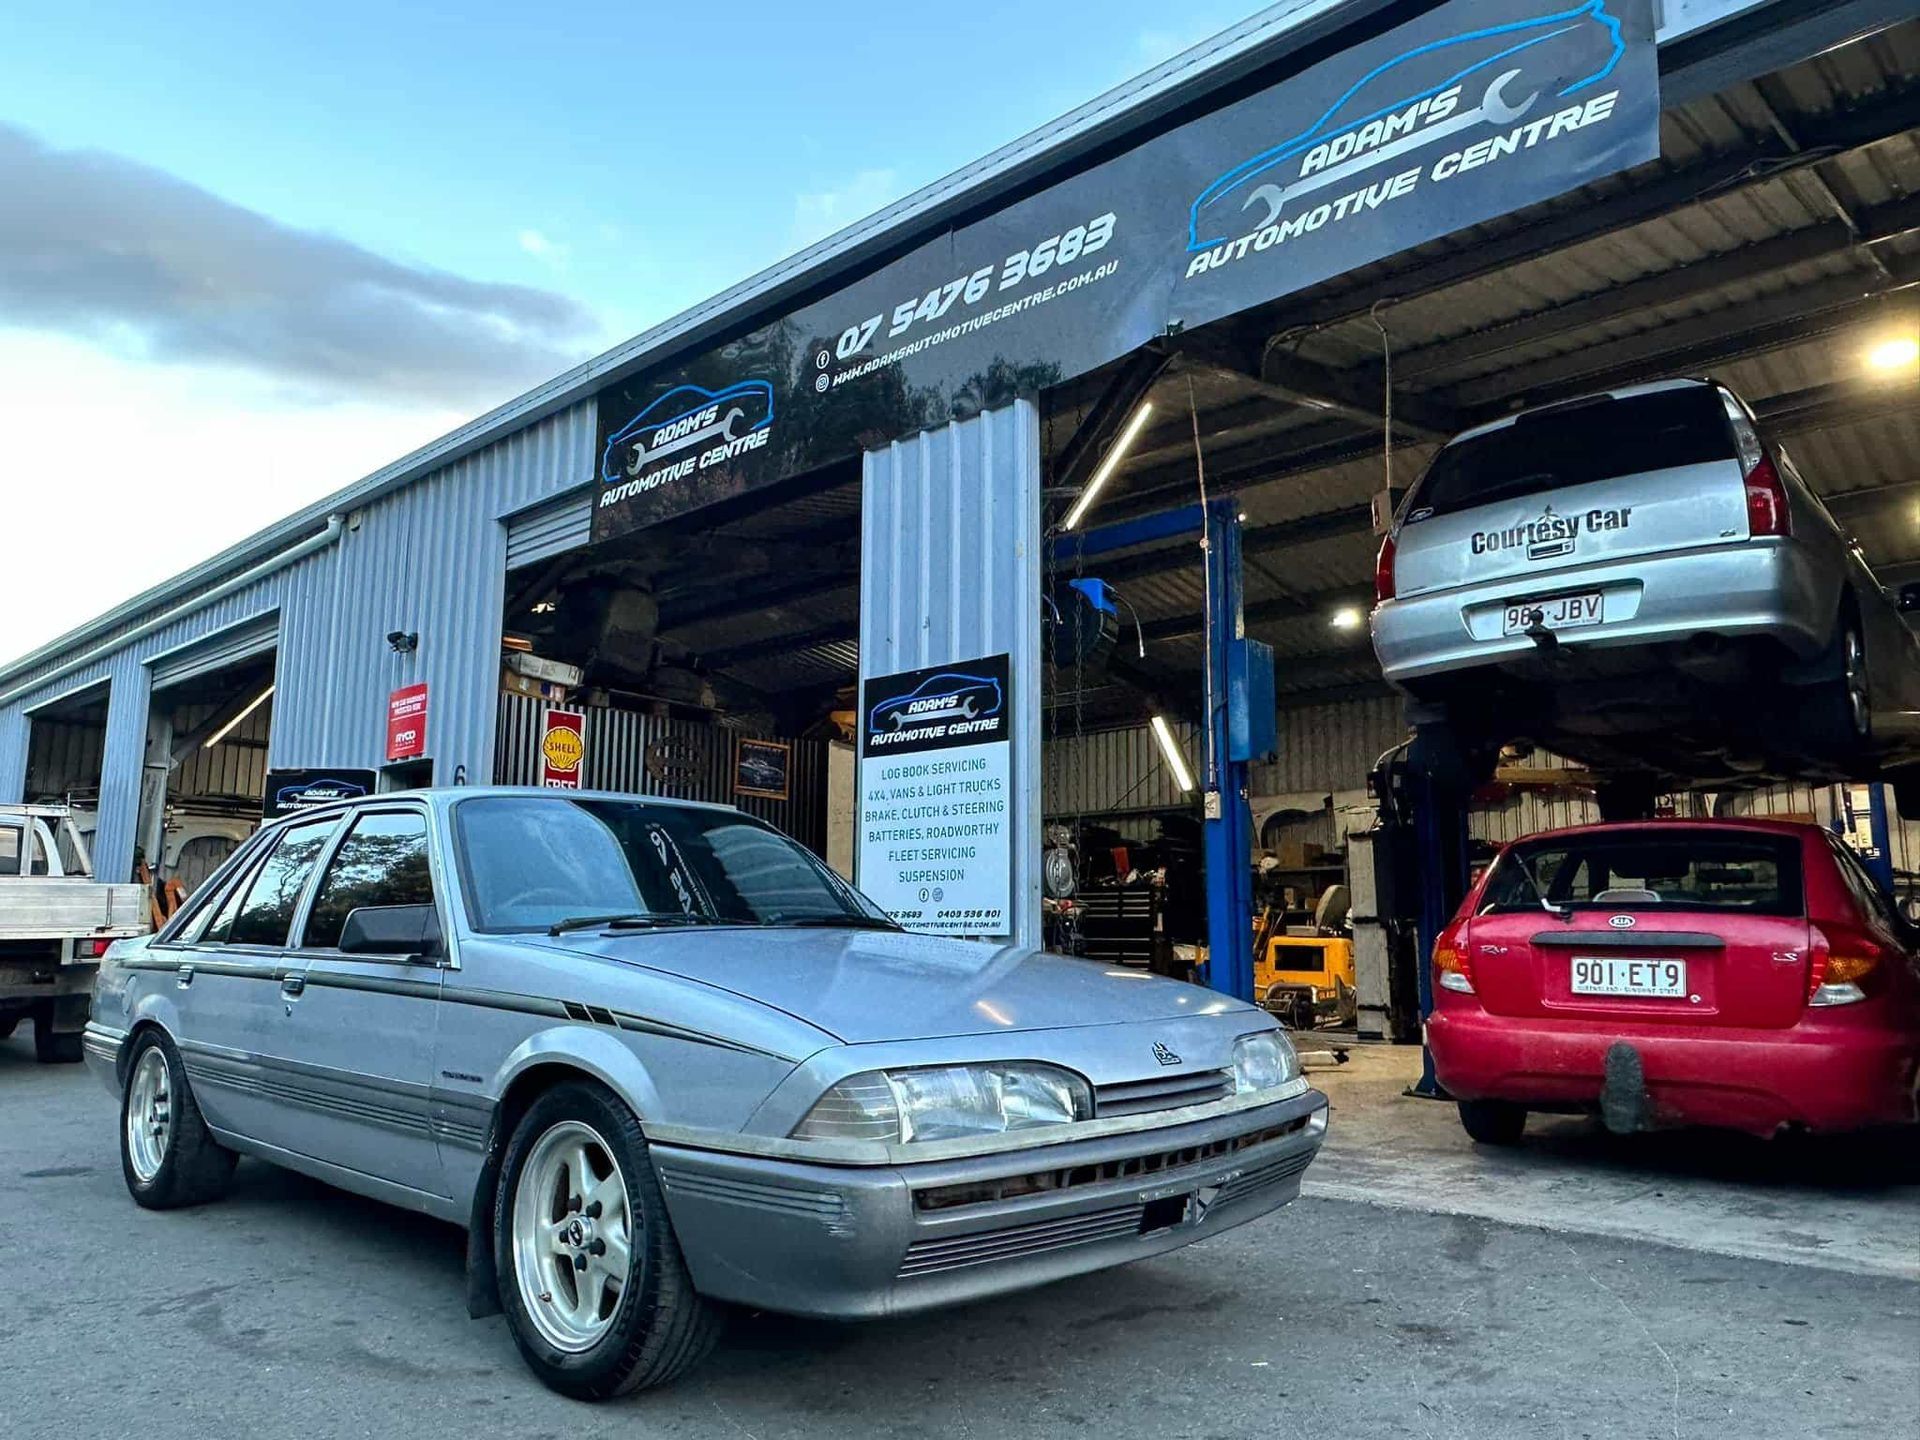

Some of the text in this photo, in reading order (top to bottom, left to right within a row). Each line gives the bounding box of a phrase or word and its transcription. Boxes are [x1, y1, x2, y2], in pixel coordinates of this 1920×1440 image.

[1299, 84, 1463, 178] ADAM'S
[1184, 90, 1620, 279] AUTOMOTIVE CENTRE
[835, 211, 1118, 361] 07 5476 3683
[652, 404, 719, 448] ADAM'S
[600, 427, 771, 508] AUTOMOTIVE CENTRE
[1471, 508, 1632, 554] Courtesy Car
[908, 695, 959, 713] ADAM'S
[870, 717, 1000, 746] AUTOMOTIVE CENTRE
[548, 742, 576, 755] SHELL
[881, 758, 986, 780] LOG BOOK SERVICING
[890, 786, 915, 799] VANS
[918, 786, 925, 797] &
[927, 782, 957, 796] LIGHT
[959, 778, 1001, 793] TRUCKS
[865, 800, 1004, 822] BRAKE, CLUTCH & STEERING
[869, 823, 999, 842] BATTERIES, ROADWORTHY
[889, 846, 976, 862] FLEET SERVICING
[899, 869, 965, 883] SUSPENSION
